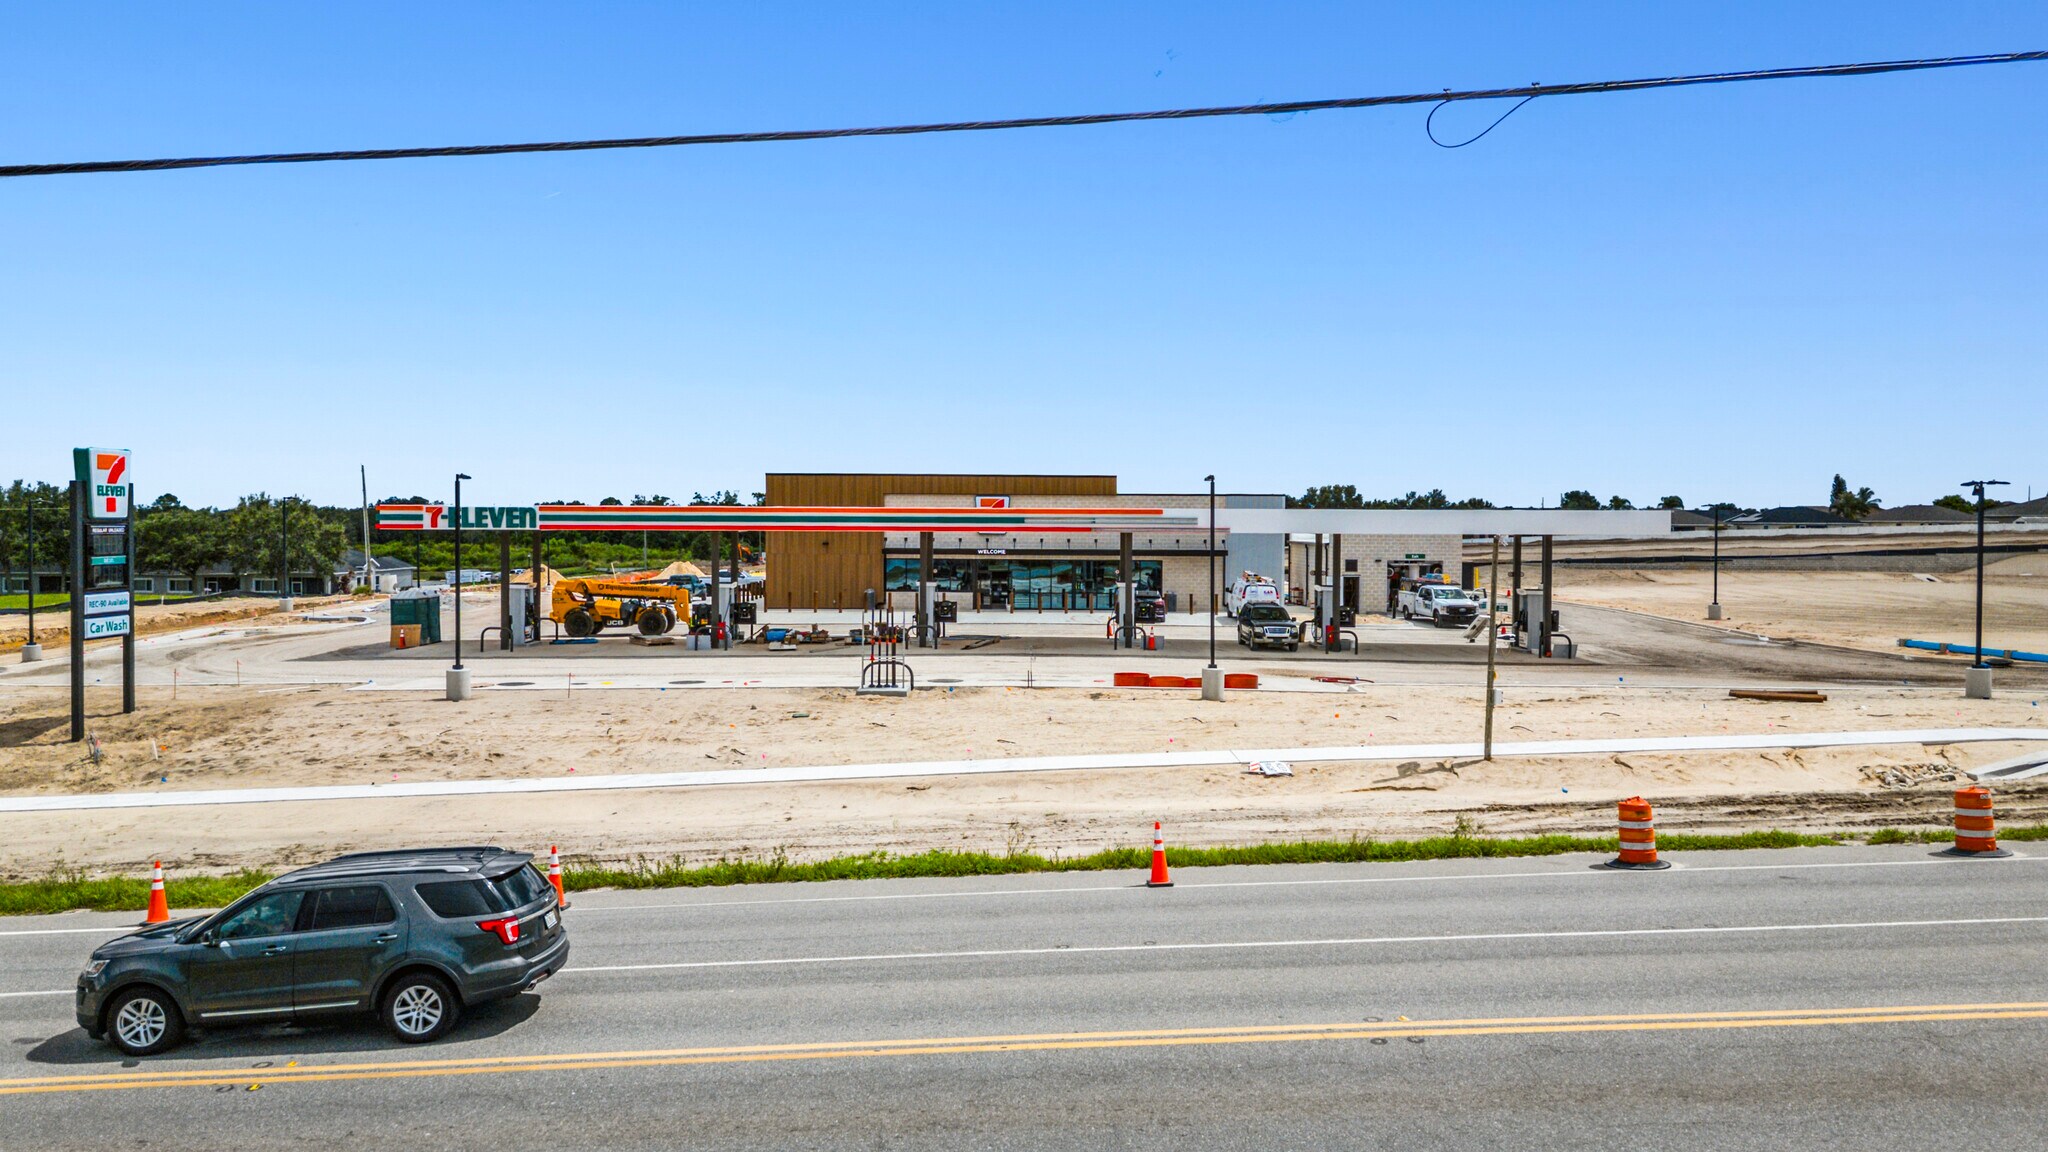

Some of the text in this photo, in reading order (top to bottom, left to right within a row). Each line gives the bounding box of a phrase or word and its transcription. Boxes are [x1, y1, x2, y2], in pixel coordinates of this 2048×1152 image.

[89, 598, 128, 609] REC-90 Available
[90, 619, 128, 634] Car Wash
